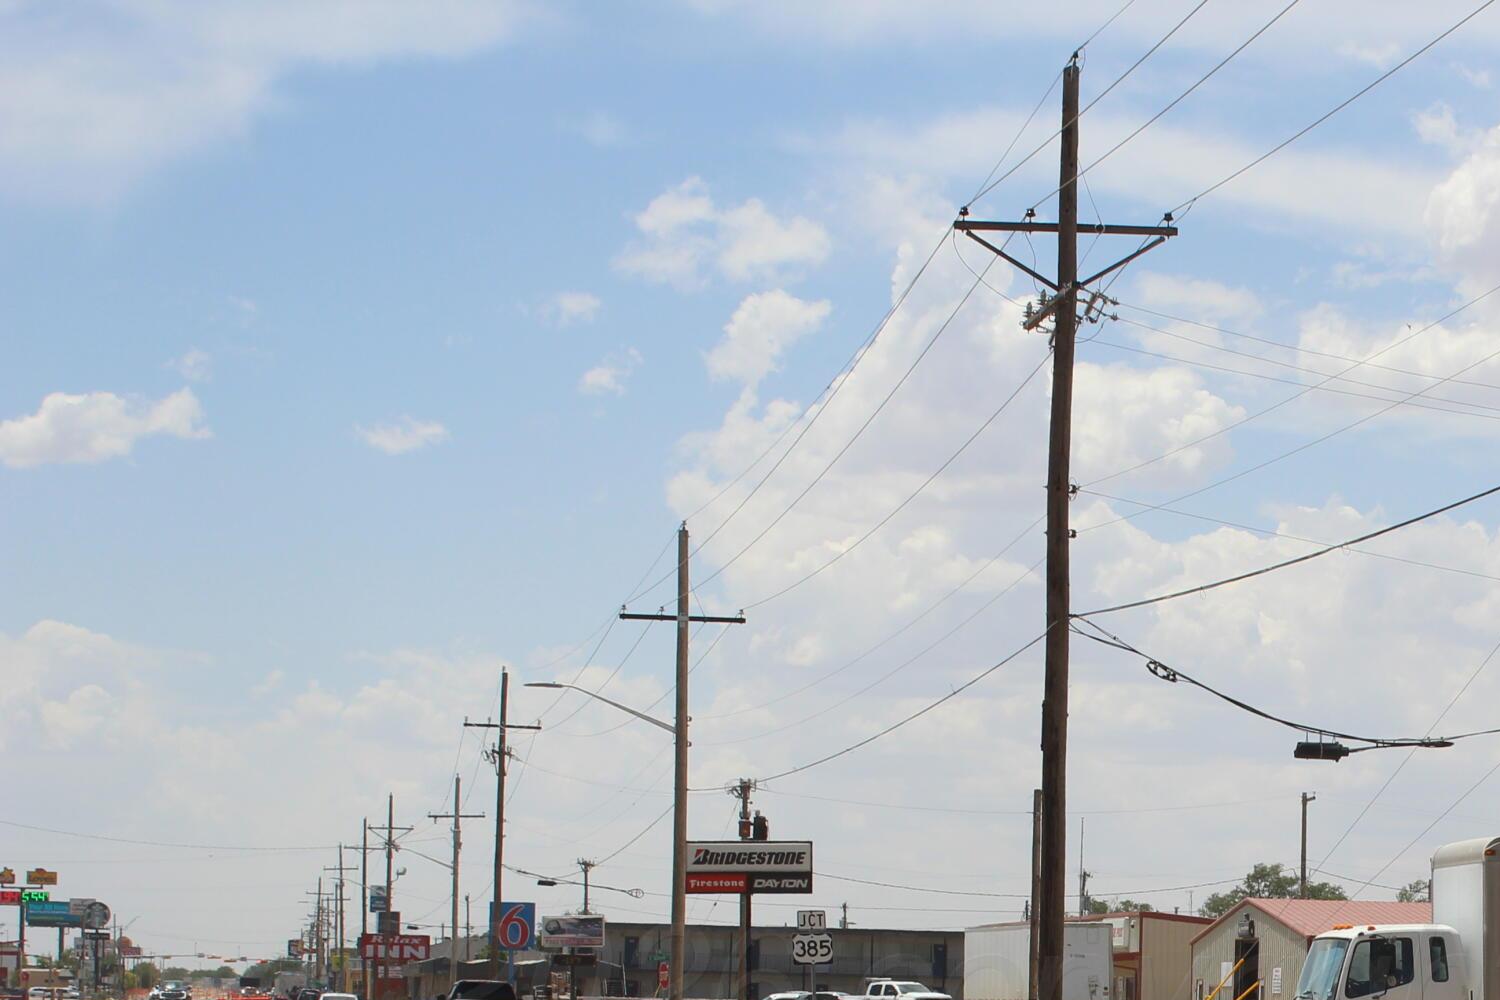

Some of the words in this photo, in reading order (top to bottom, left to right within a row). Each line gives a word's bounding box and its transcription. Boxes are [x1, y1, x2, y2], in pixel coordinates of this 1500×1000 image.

[692, 848, 806, 865] BRIDGESTONE
[690, 879, 745, 888] Firestone
[753, 879, 808, 888] DAYTON
[500, 904, 530, 949] 6
[800, 914, 823, 927] JCT
[372, 935, 421, 944] Rlax
[366, 944, 426, 958] INN
[795, 940, 831, 957] 385
